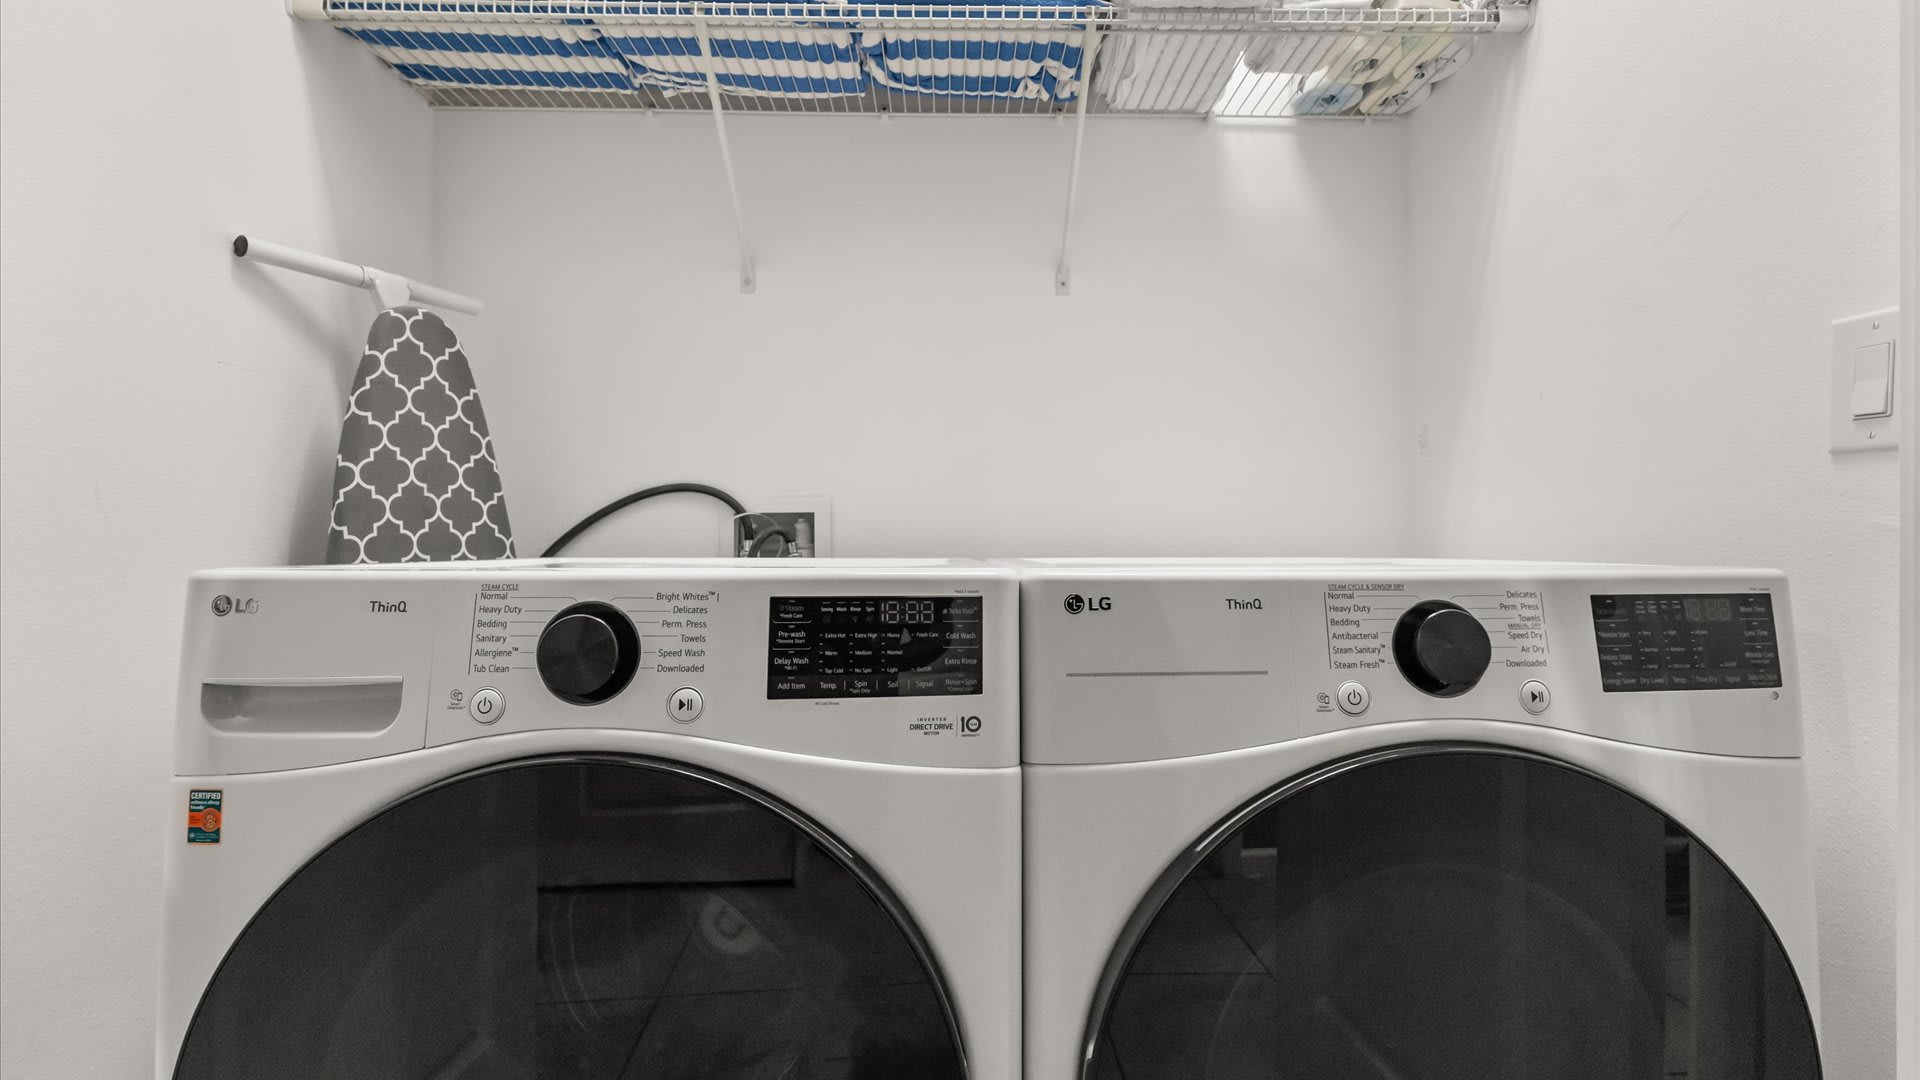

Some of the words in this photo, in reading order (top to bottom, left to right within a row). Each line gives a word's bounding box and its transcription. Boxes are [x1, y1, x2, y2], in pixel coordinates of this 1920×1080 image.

[480, 592, 508, 600] Normal
[656, 592, 680, 603] Bright
[1327, 592, 1355, 600] Normal
[1506, 591, 1537, 599] Delicates
[369, 601, 408, 613] ThinQ
[1088, 597, 1112, 611] LG
[1225, 598, 1263, 610] ThinQ
[1520, 603, 1539, 611] Press
[479, 605, 502, 615] Heavy
[504, 605, 522, 615] Duty
[672, 606, 708, 614] Delicates
[1329, 605, 1352, 614] Heavy
[1353, 605, 1371, 614] Duty
[1518, 614, 1540, 622] Towels
[476, 620, 508, 630] Bedding
[686, 620, 708, 628] Press
[1330, 618, 1360, 628] Bedding
[681, 634, 706, 643] Towels
[778, 630, 806, 638] Pre-wash
[961, 632, 976, 640] Wash
[1332, 632, 1379, 640] Antibacterial
[1508, 631, 1529, 640] Speed
[1531, 631, 1542, 640] Dry
[476, 634, 507, 644] Sanitary
[658, 649, 682, 658] Speed
[685, 649, 705, 657] Wash
[1332, 646, 1354, 654] Steam
[1521, 645, 1530, 653] Air
[1533, 645, 1545, 654] Dry
[657, 664, 705, 673] Downloaded
[1334, 661, 1357, 669] Steam
[1506, 660, 1547, 668] Downloaded
[473, 665, 486, 673] Tub
[488, 665, 510, 673] Clean
[961, 716, 982, 733] 10
